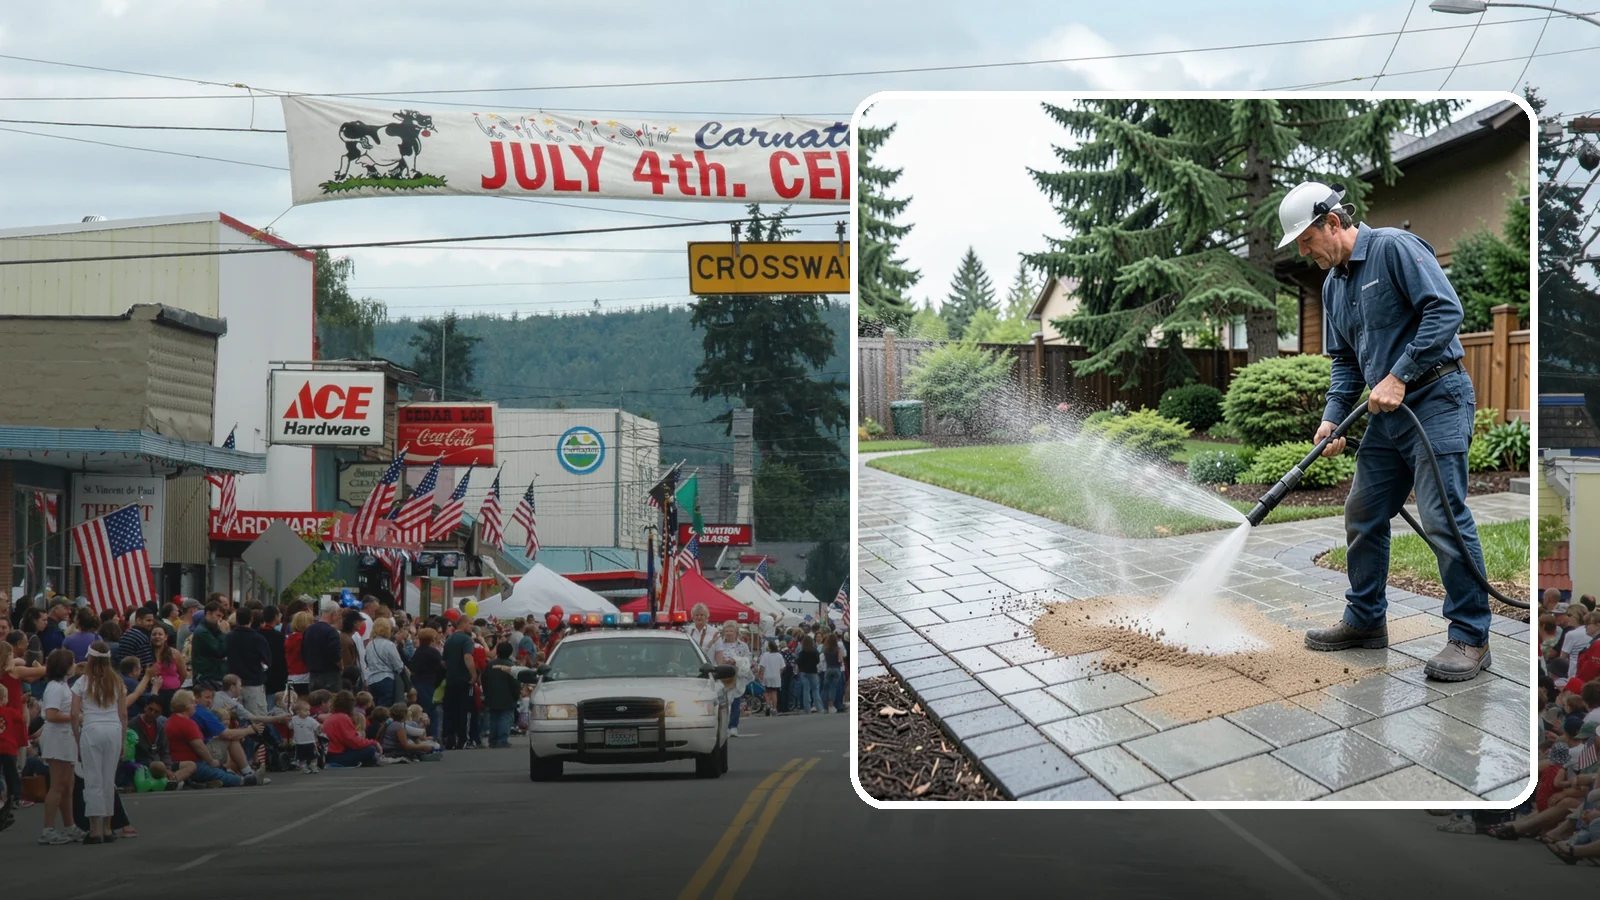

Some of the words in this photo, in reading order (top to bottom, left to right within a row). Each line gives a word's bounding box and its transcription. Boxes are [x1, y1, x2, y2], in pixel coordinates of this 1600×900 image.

[695, 121, 850, 150] Carnat
[481, 141, 605, 192] JULY
[632, 150, 746, 198] 4th.
[697, 254, 850, 280] CROSSWA
[283, 380, 373, 420] ACE
[406, 409, 452, 422] CEDAR
[461, 409, 485, 421] LOG
[283, 421, 370, 436] Hardware
[416, 428, 476, 447] Coca-Cola
[83, 485, 93, 494] St.
[96, 485, 124, 494] Vincent
[126, 485, 136, 495] de
[137, 485, 155, 495] Paul
[688, 526, 741, 535] CRNATION
[699, 535, 730, 543] GLASS
